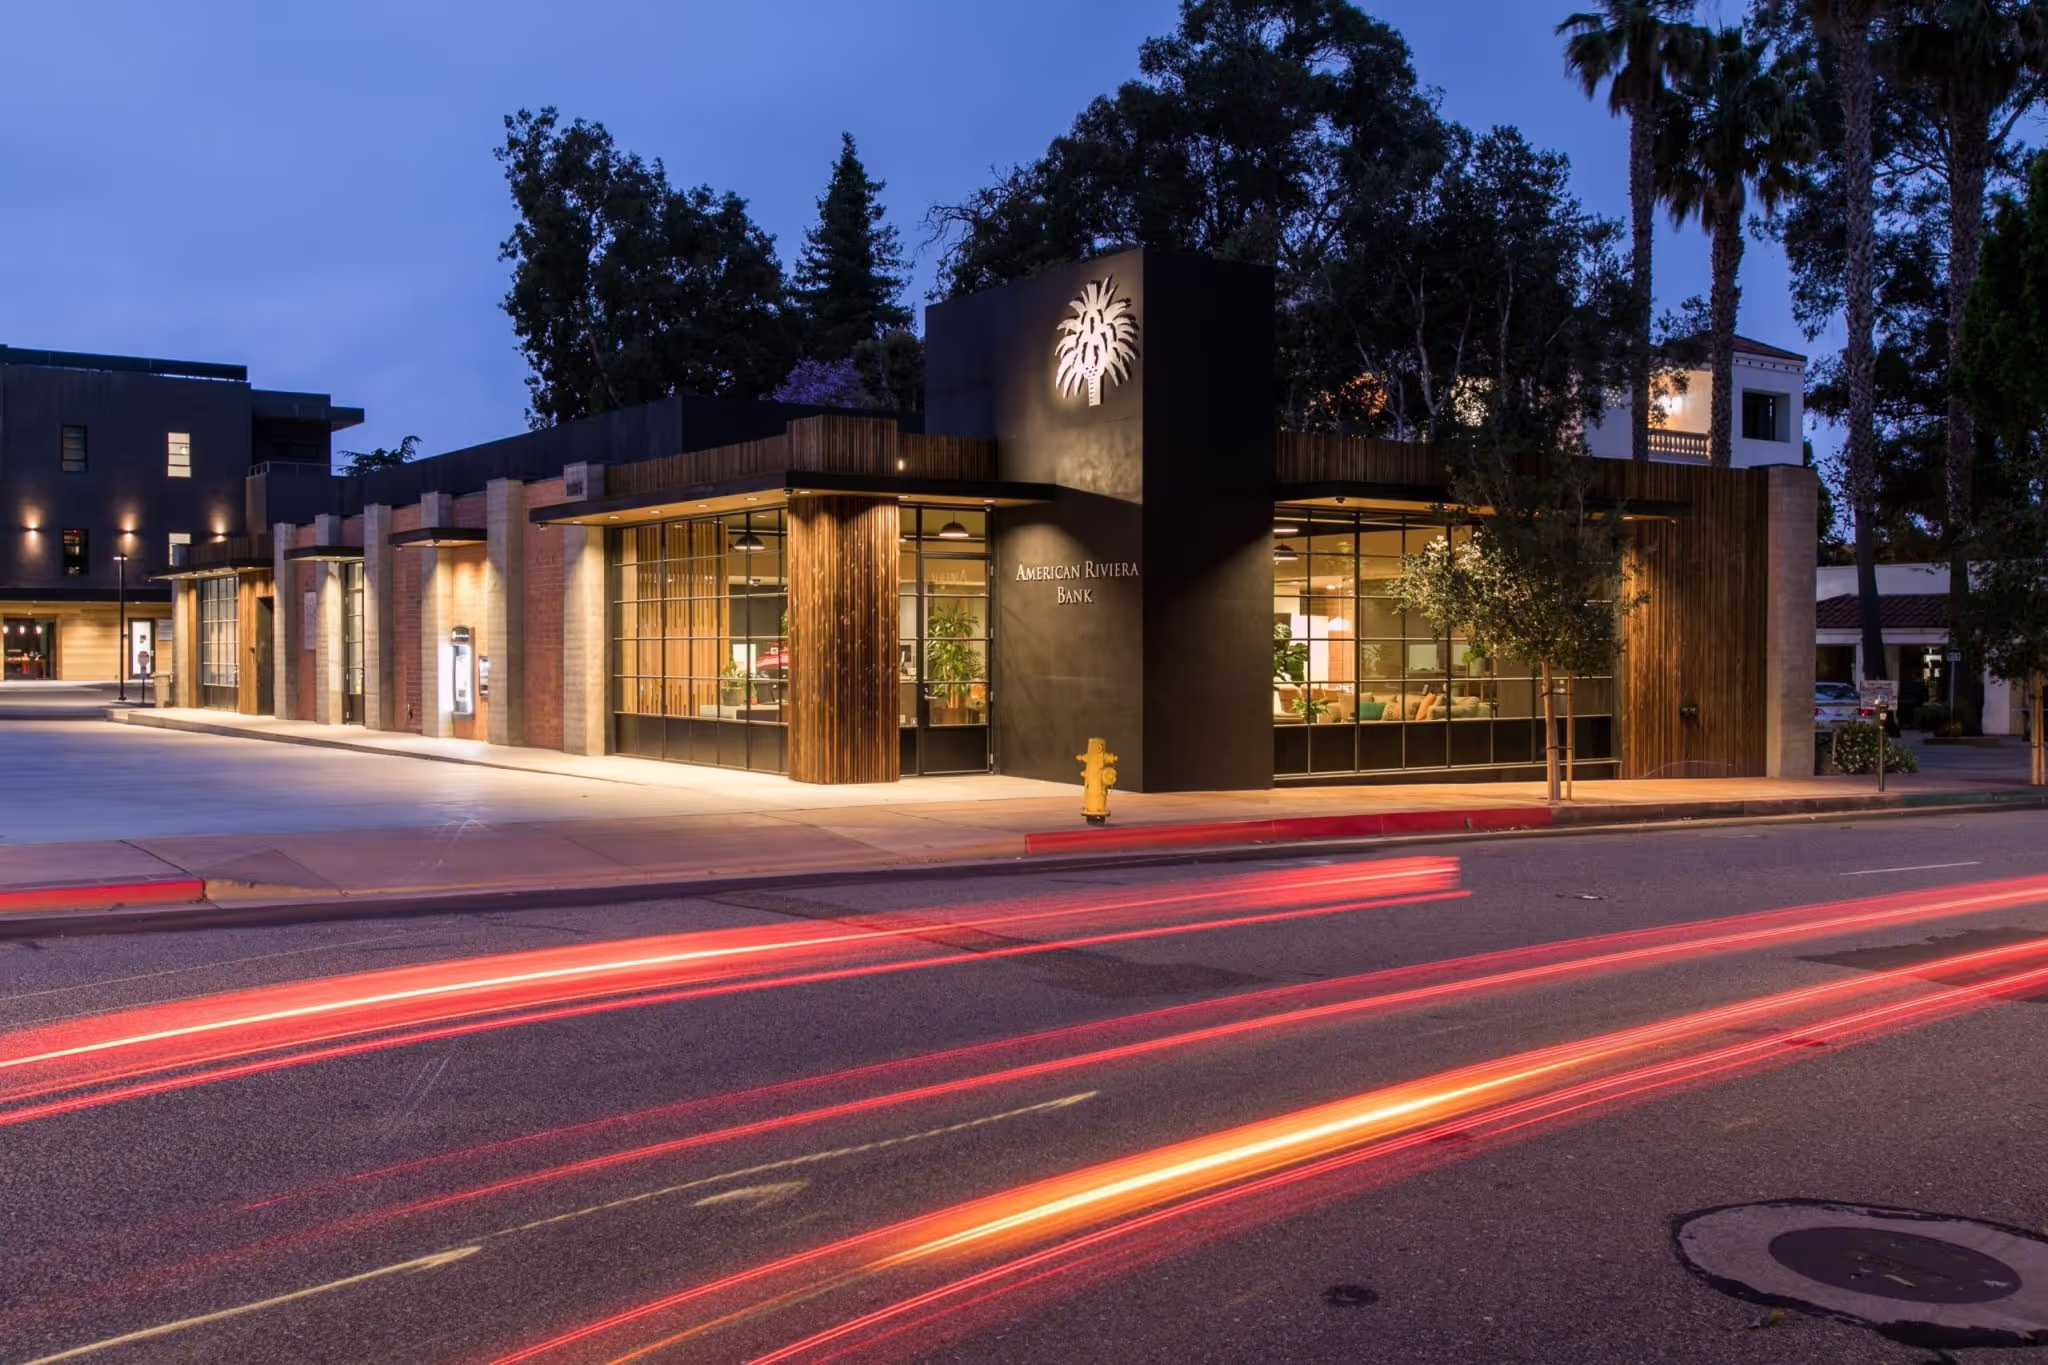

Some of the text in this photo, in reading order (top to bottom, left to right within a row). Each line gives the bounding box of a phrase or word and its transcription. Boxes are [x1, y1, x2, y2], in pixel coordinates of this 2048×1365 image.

[1015, 560, 1140, 581] AMERICAN RIVIERA
[1057, 586, 1094, 604] BANK
